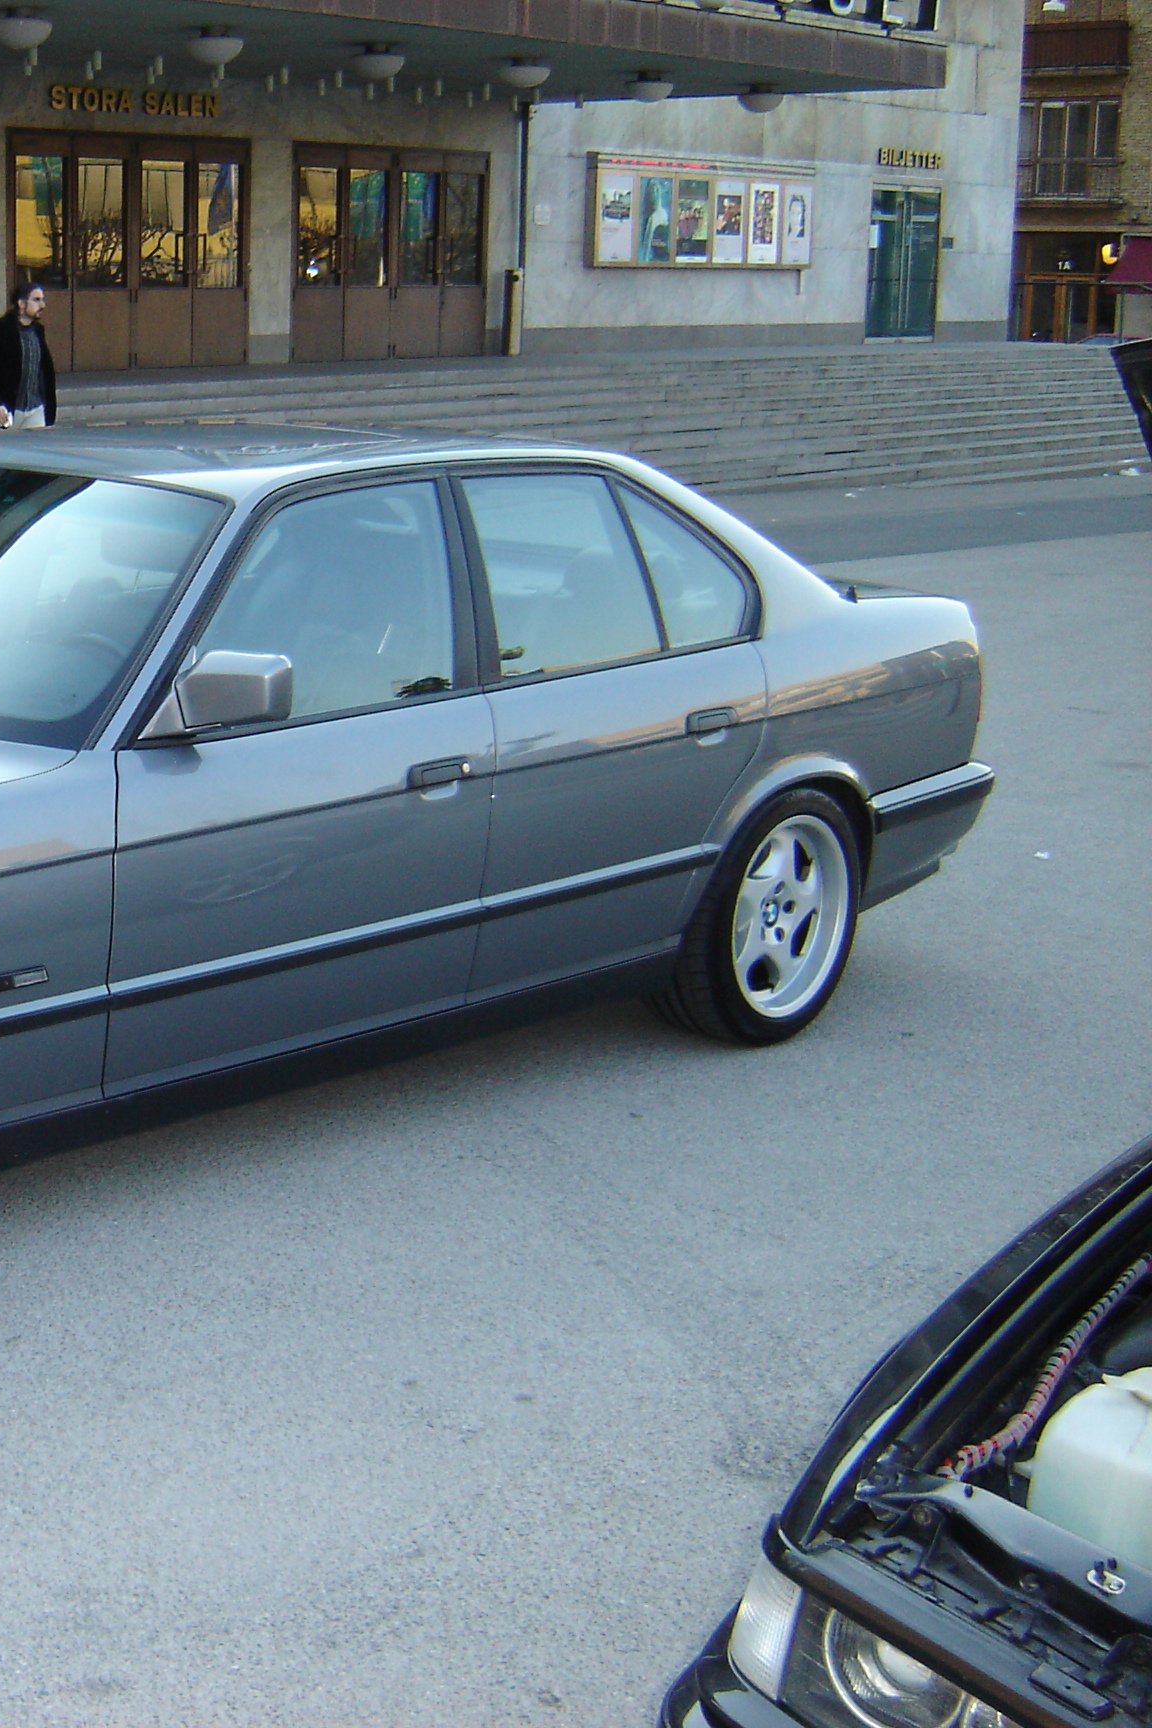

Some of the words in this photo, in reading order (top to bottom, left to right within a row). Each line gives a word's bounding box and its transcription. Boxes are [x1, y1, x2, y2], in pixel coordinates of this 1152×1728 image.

[50, 85, 132, 112] STORA
[145, 90, 221, 118] SALEN
[878, 147, 943, 169] BILJETTER
[1058, 260, 1071, 271] 1A
